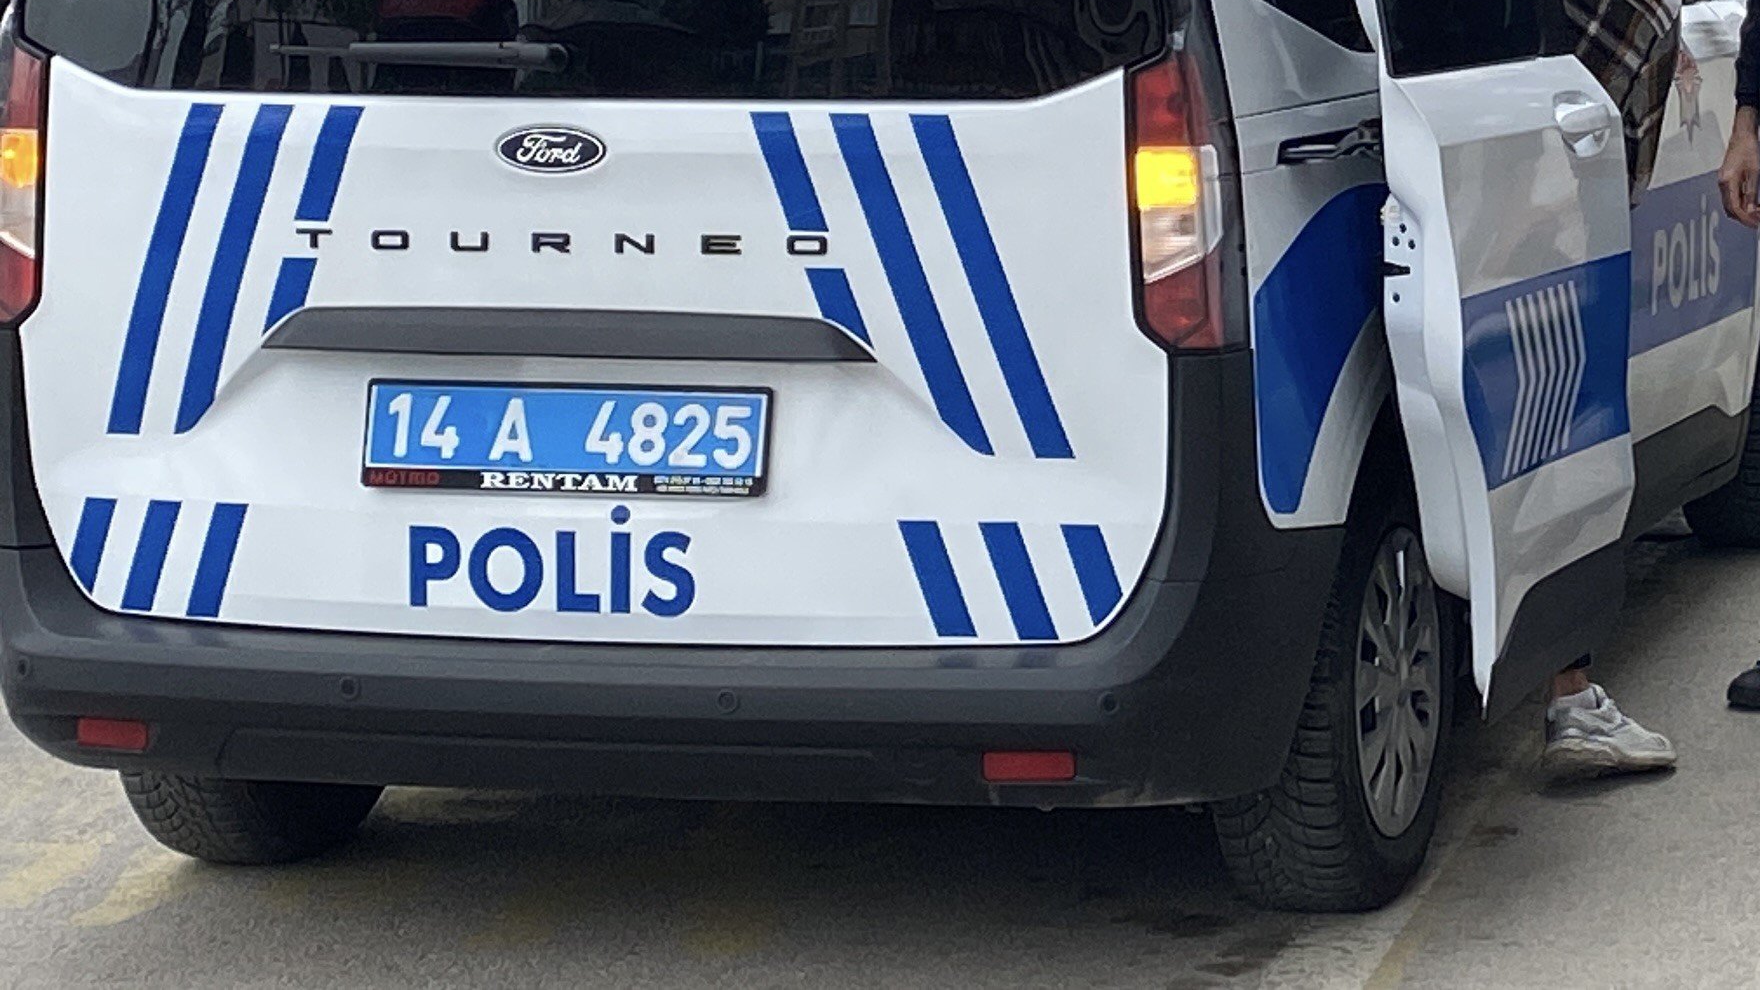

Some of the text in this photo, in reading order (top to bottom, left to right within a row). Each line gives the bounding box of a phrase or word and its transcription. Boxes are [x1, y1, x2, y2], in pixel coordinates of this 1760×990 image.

[516, 133, 583, 166] Ford
[296, 228, 829, 256] TOURNEO
[1651, 194, 1721, 316] POLİS
[388, 392, 752, 470] 14 A 4825
[480, 471, 638, 492] RENTAM
[409, 504, 696, 618] POLİS
